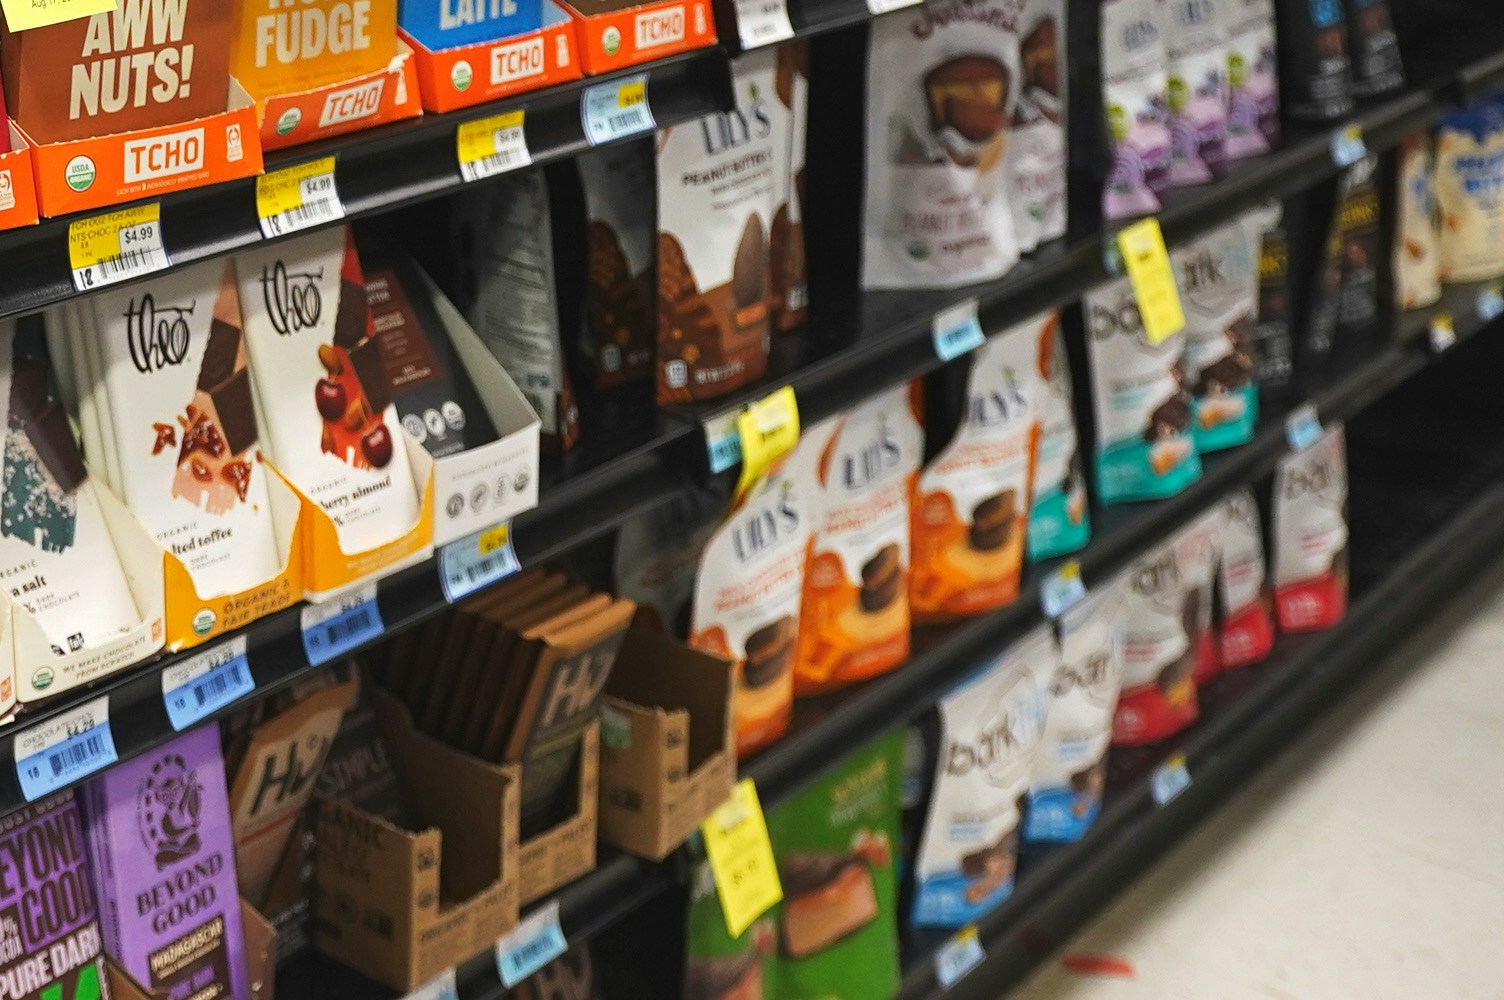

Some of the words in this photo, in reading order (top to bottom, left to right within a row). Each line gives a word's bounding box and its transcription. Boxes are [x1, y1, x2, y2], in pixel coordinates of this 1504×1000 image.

[31, 0, 46, 9] Aug
[255, 0, 371, 68] FUDGE
[69, 44, 194, 121] NUTS!
[130, 137, 198, 171] TCHO
[136, 853, 223, 916] BEYOND
[151, 885, 216, 933] GOOD
